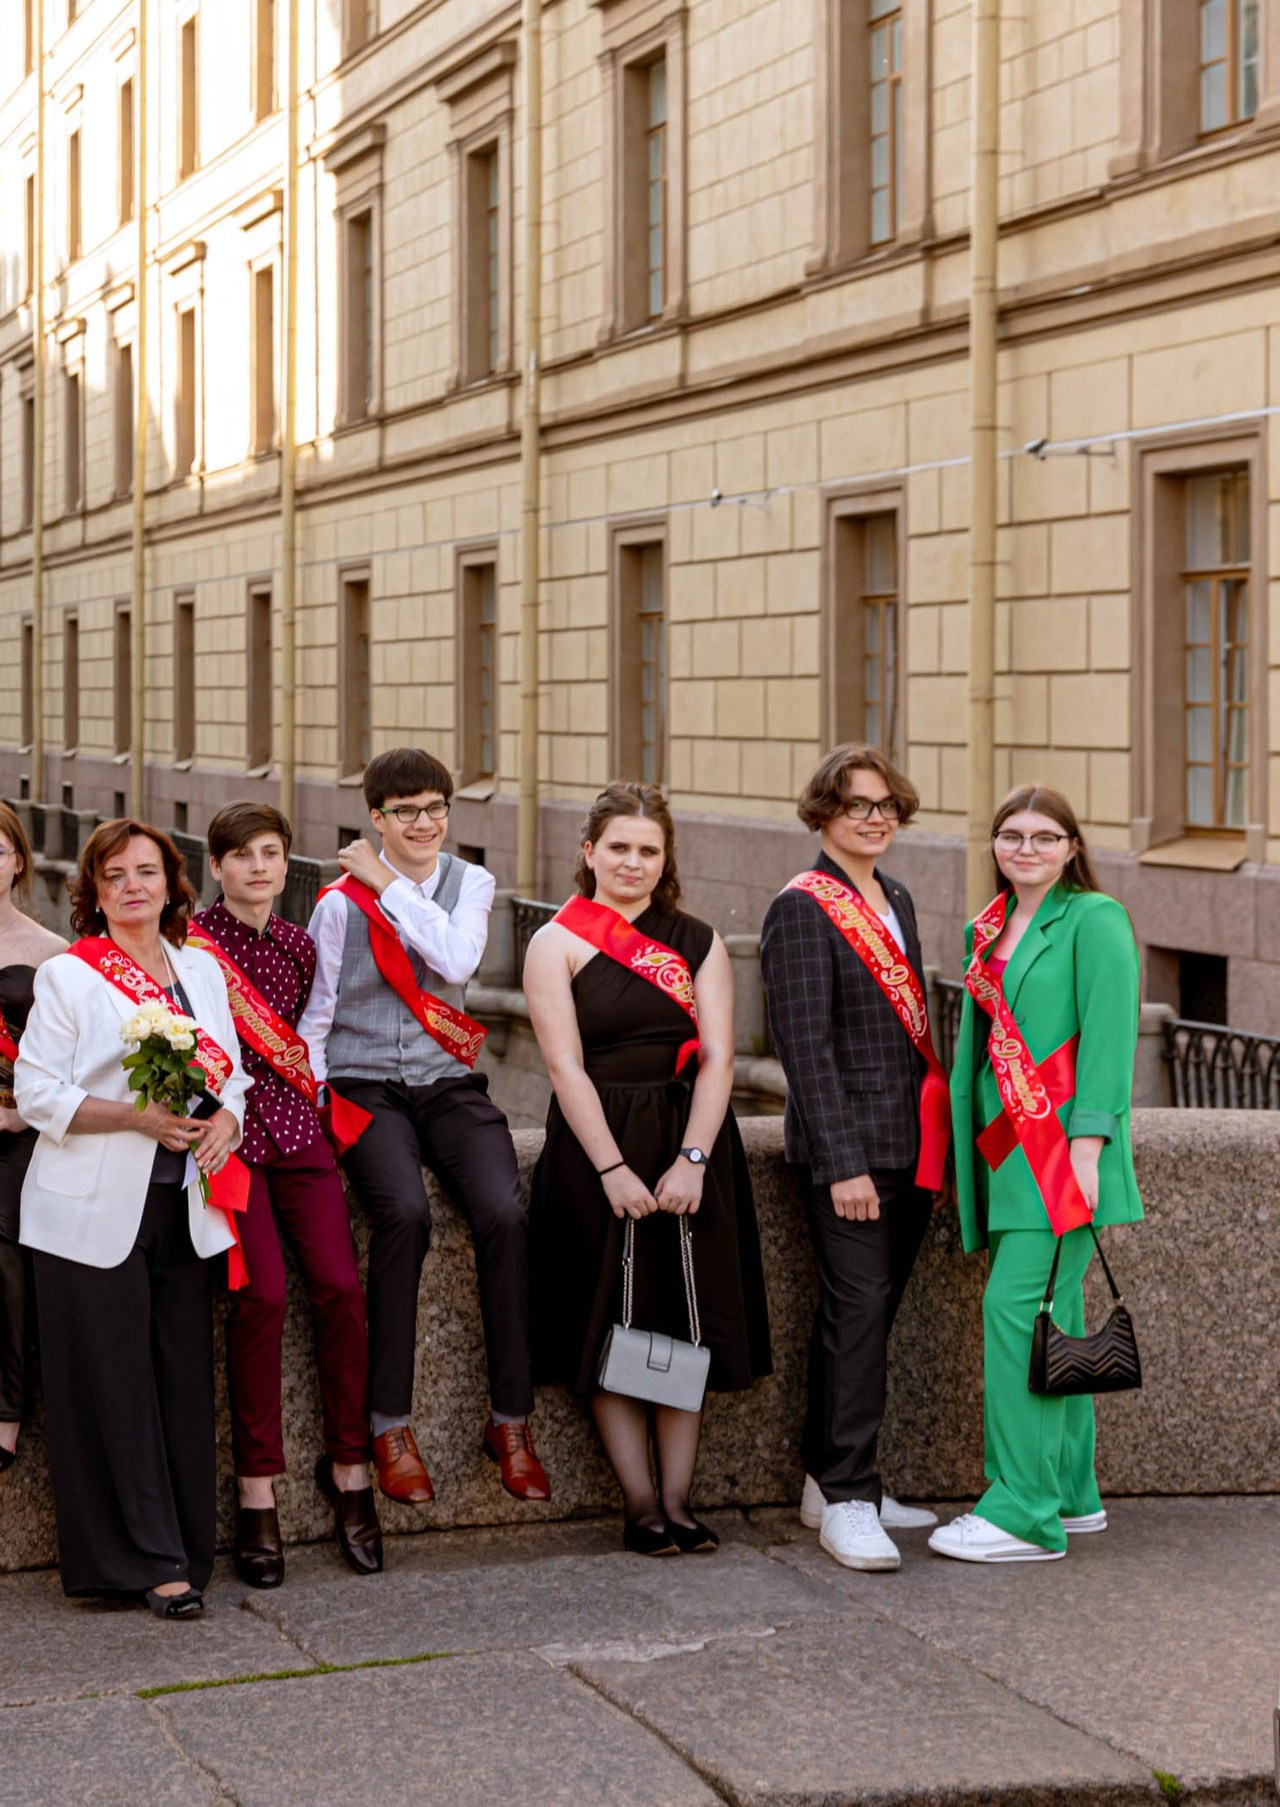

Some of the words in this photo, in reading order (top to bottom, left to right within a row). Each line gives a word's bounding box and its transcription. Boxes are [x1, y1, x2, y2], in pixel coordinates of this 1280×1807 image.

[796, 873, 894, 968] Выпускник
[881, 964, 909, 986] 9
[273, 1045, 305, 1066] 9
[461, 1032, 485, 1057] 9
[992, 1038, 1022, 1059] 9
[1008, 1059, 1038, 1113] класса
